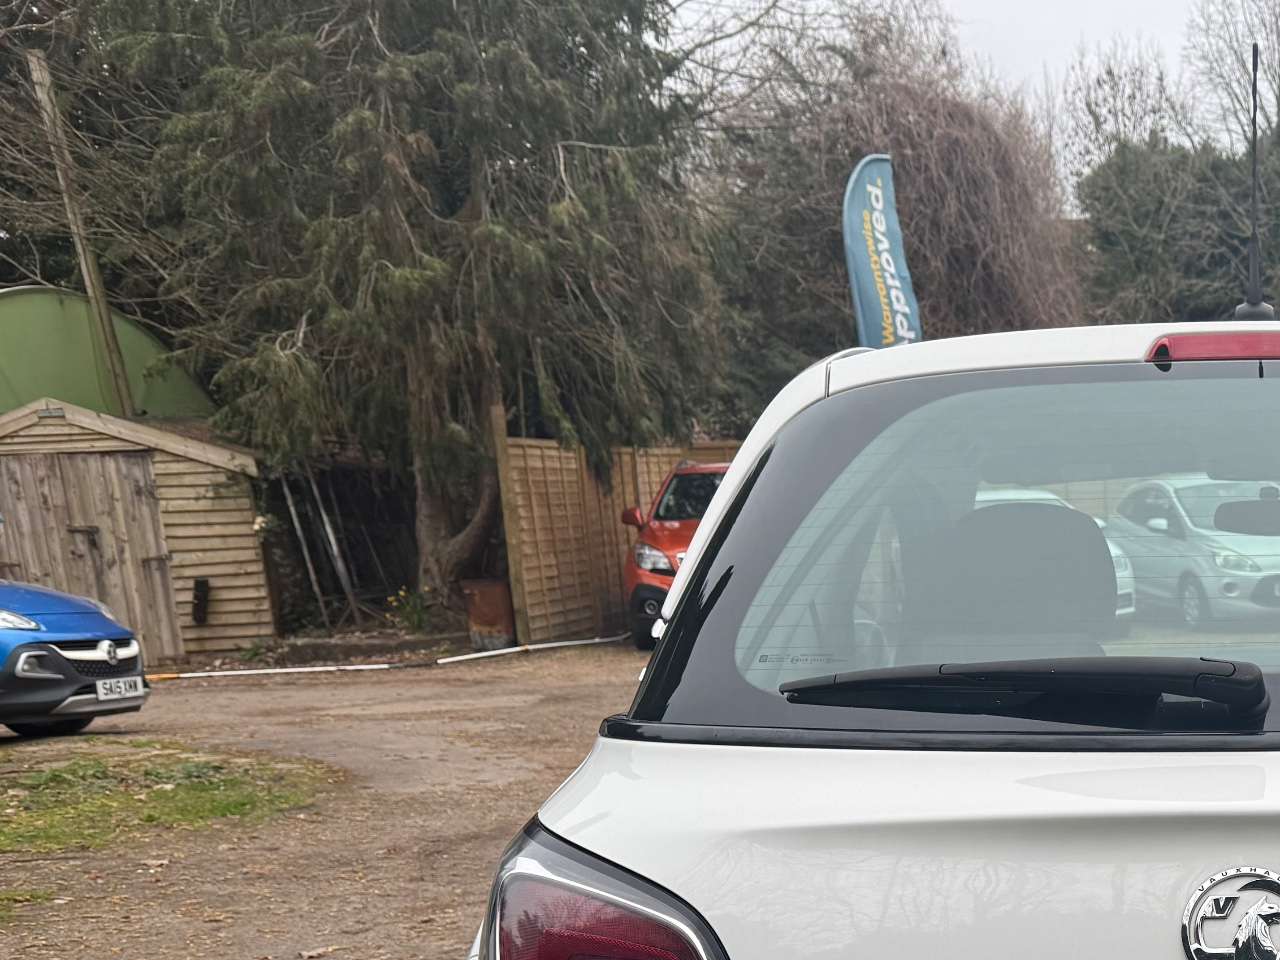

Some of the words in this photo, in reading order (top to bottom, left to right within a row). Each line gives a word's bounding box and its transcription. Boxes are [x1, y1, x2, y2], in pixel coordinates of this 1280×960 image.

[863, 209, 896, 346] Warrantywise
[866, 176, 916, 345] pproved.
[102, 680, 122, 696] SA15
